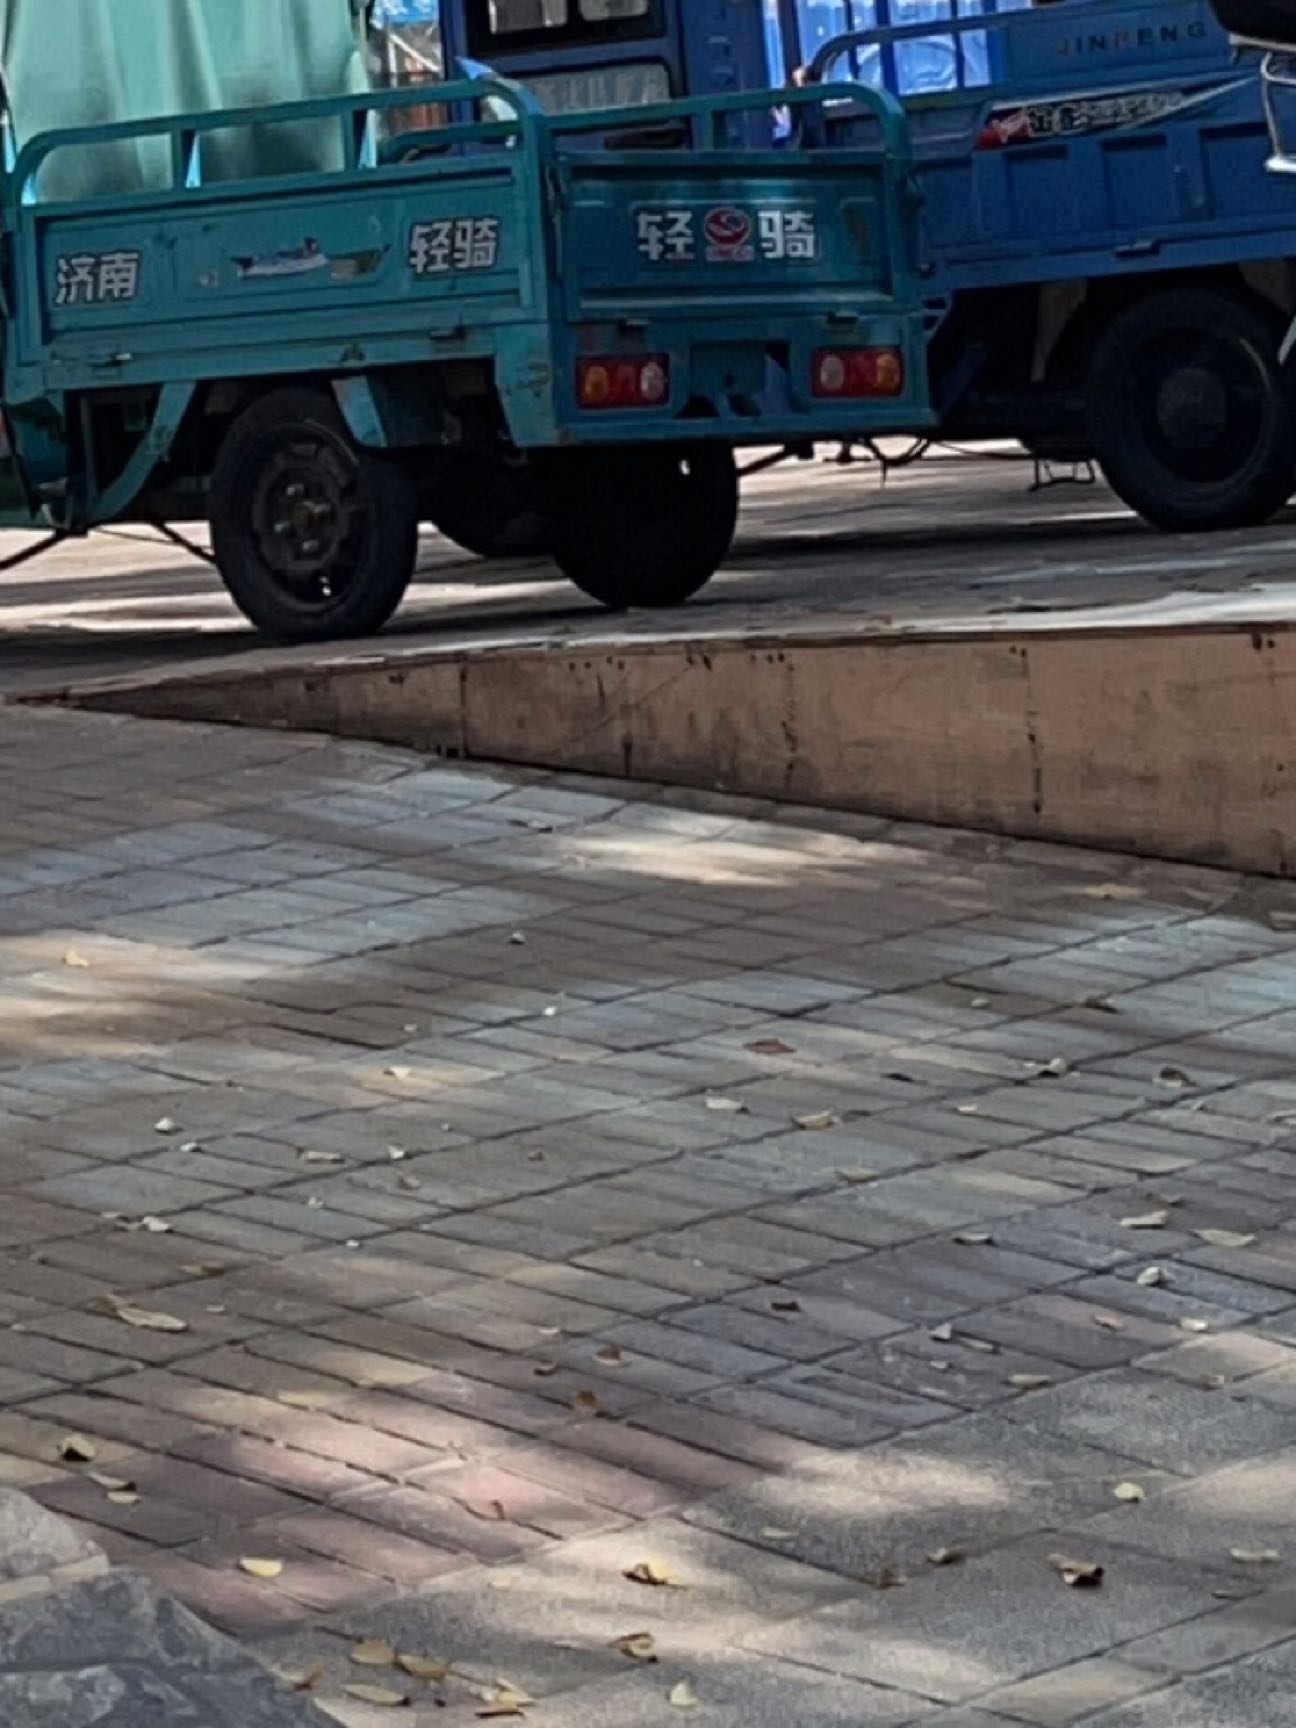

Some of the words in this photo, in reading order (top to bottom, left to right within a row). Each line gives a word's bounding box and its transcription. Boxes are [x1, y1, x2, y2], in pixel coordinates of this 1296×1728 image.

[409, 217, 499, 274] 轻骑
[637, 209, 696, 260] 轻
[756, 209, 816, 259] 骑
[55, 252, 139, 304] 济南
